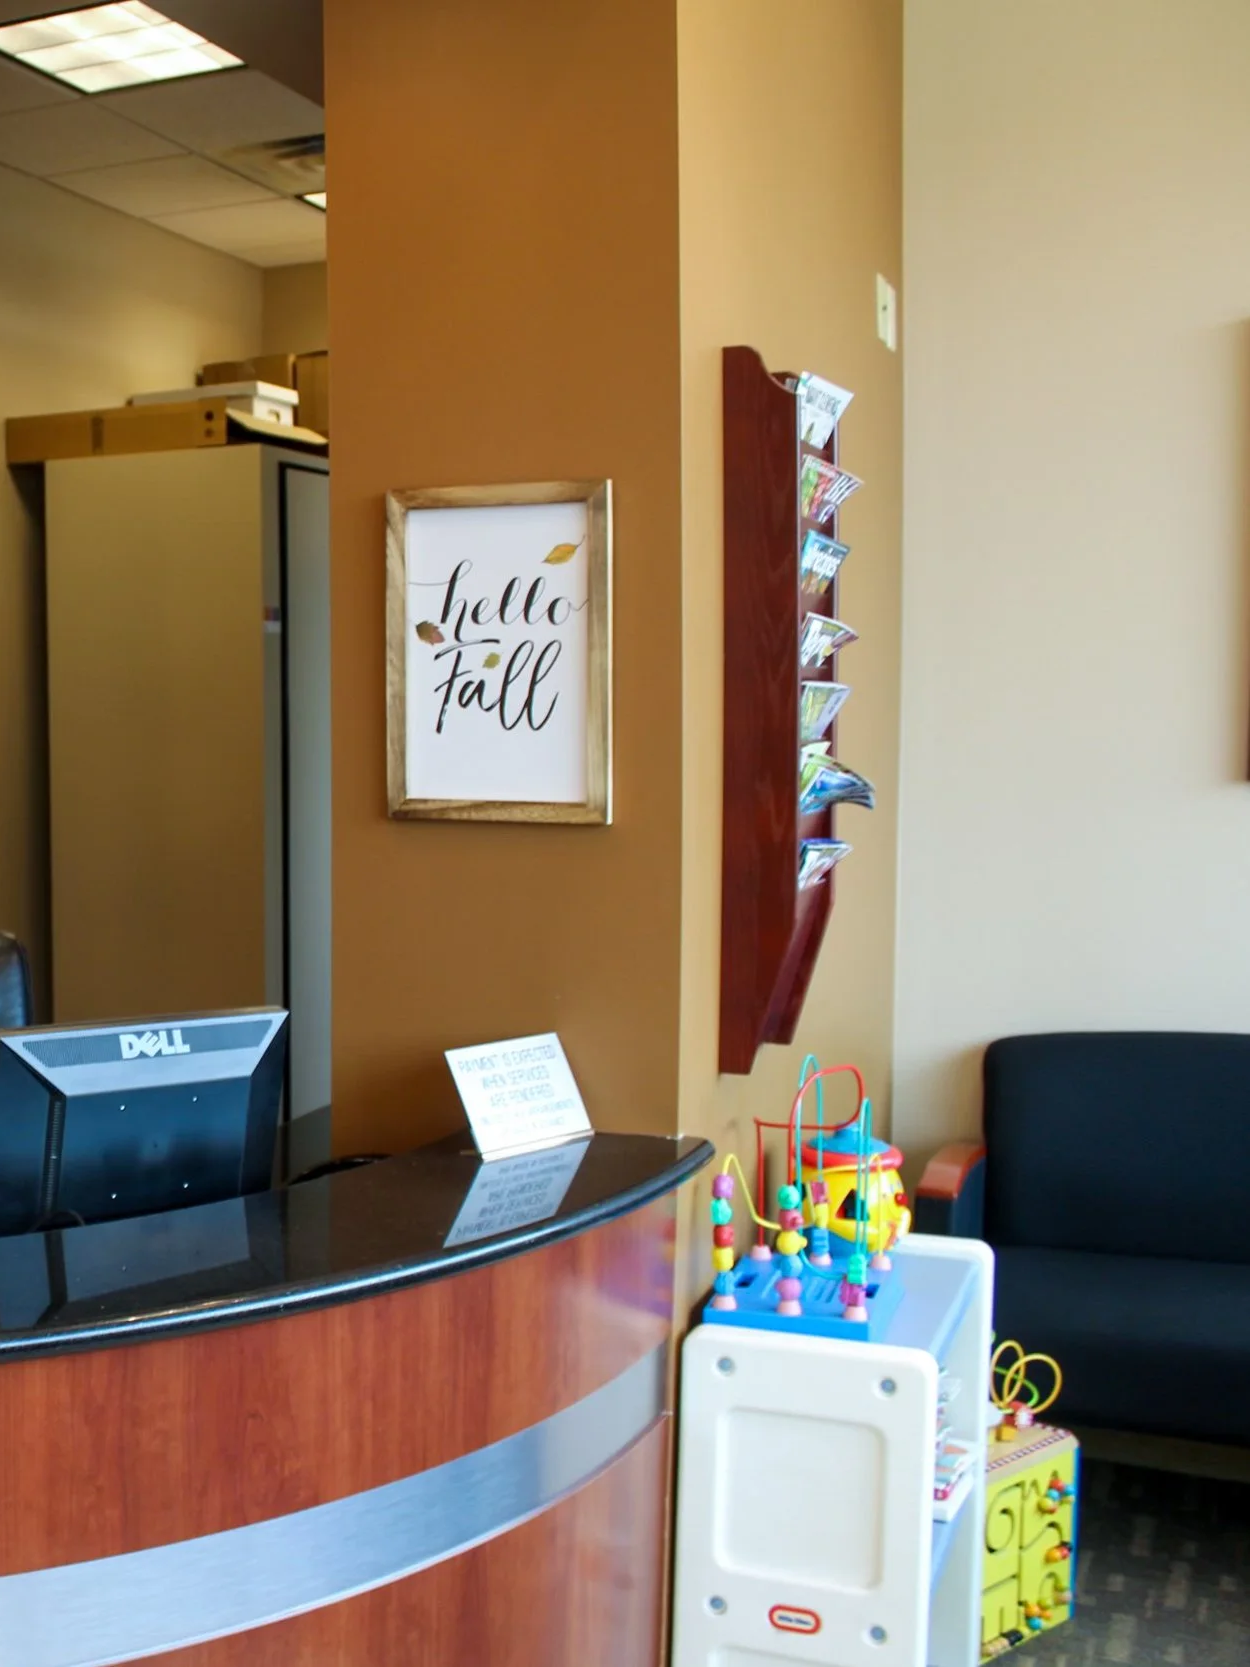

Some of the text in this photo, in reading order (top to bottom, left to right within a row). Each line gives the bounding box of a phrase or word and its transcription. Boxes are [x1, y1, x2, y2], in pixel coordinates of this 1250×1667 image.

[409, 559, 589, 642] hello
[434, 639, 562, 734] Fall
[119, 1029, 190, 1060] DELL
[458, 1053, 498, 1073] PAYMENT
[512, 1044, 557, 1065] EXPECTED
[482, 1064, 551, 1089] WHEN SERVICES
